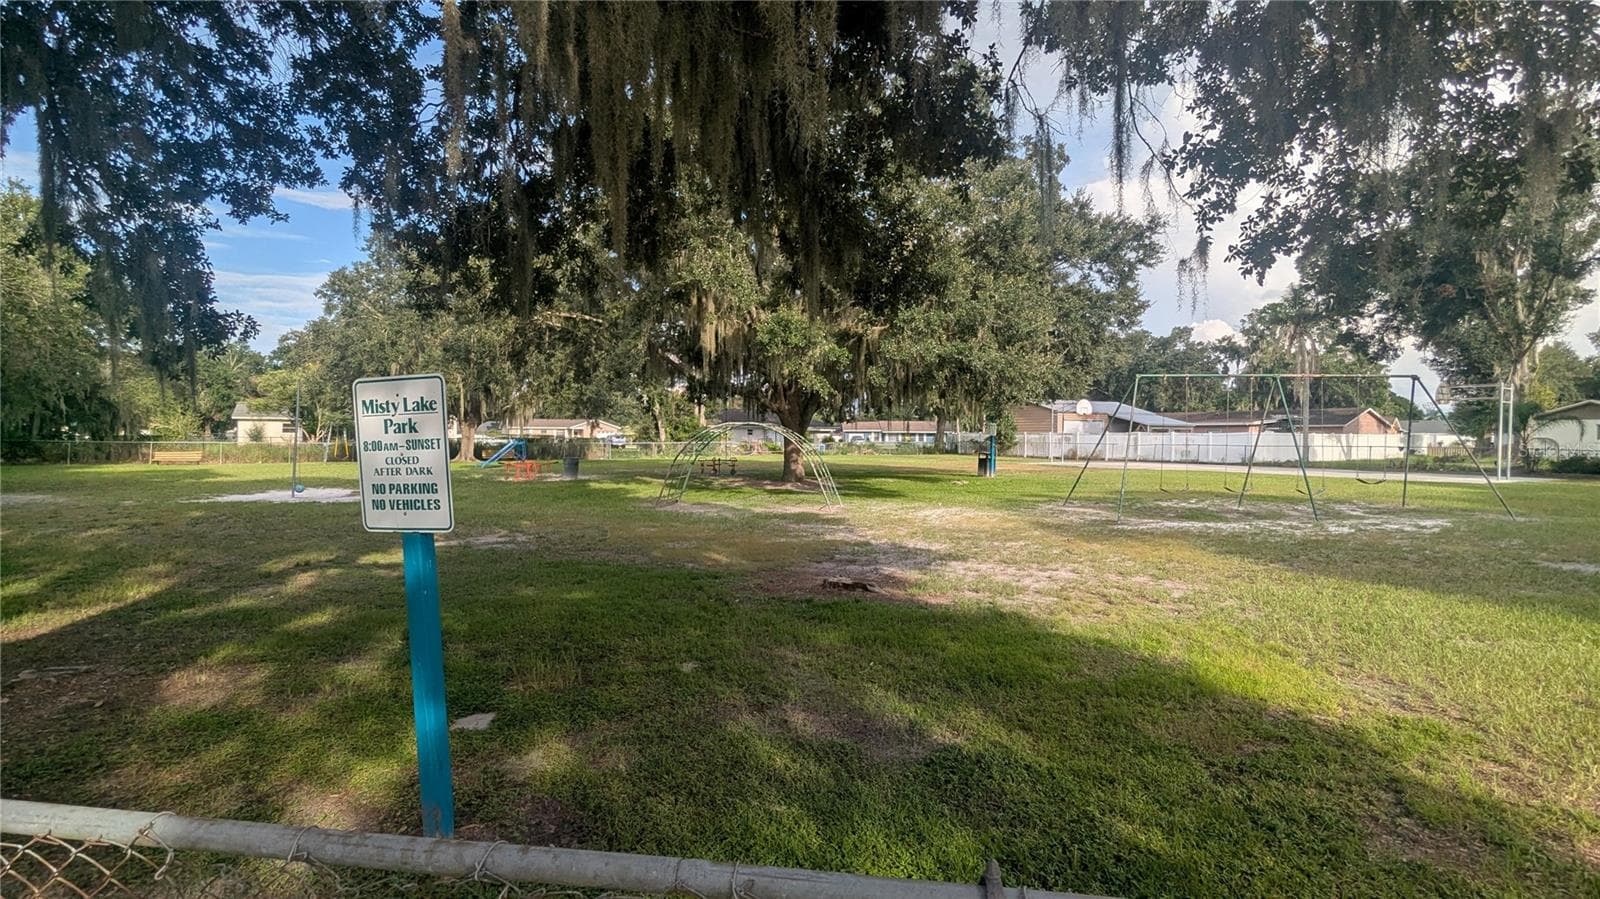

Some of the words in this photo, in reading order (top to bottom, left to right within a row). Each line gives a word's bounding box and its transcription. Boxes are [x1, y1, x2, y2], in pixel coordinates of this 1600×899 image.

[361, 398, 400, 417] Misty
[402, 396, 438, 413] Lake
[383, 417, 419, 435] Park
[385, 455, 420, 466] CLOSED
[373, 467, 402, 476] AFTER
[405, 466, 434, 476] DARK
[371, 483, 386, 495] NO
[388, 482, 439, 495] PARKING
[371, 499, 386, 511] NO
[388, 498, 441, 511] VEHICLES
